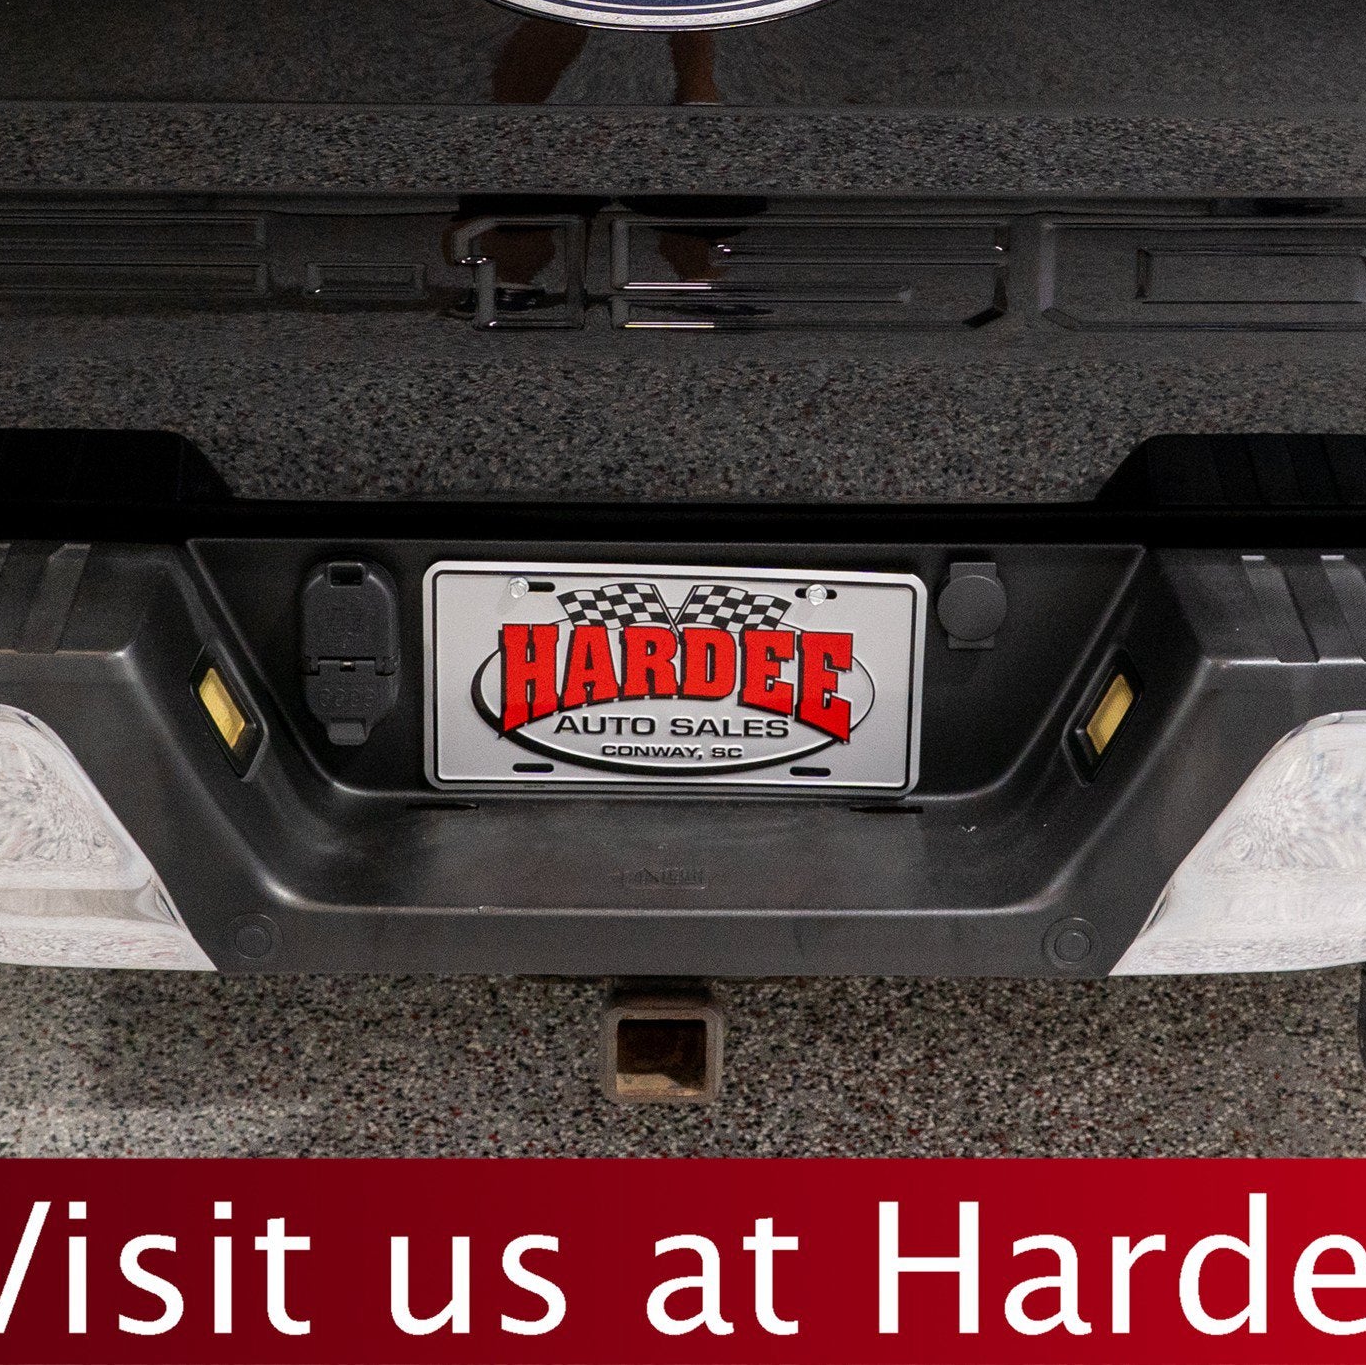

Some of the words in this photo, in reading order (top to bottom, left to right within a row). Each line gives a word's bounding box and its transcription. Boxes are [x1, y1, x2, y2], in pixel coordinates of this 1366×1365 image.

[498, 623, 853, 743] HARDEE
[554, 715, 657, 737] AUTO
[669, 716, 790, 739] SALES
[601, 743, 705, 760] CONWAY,
[711, 746, 744, 759] SC
